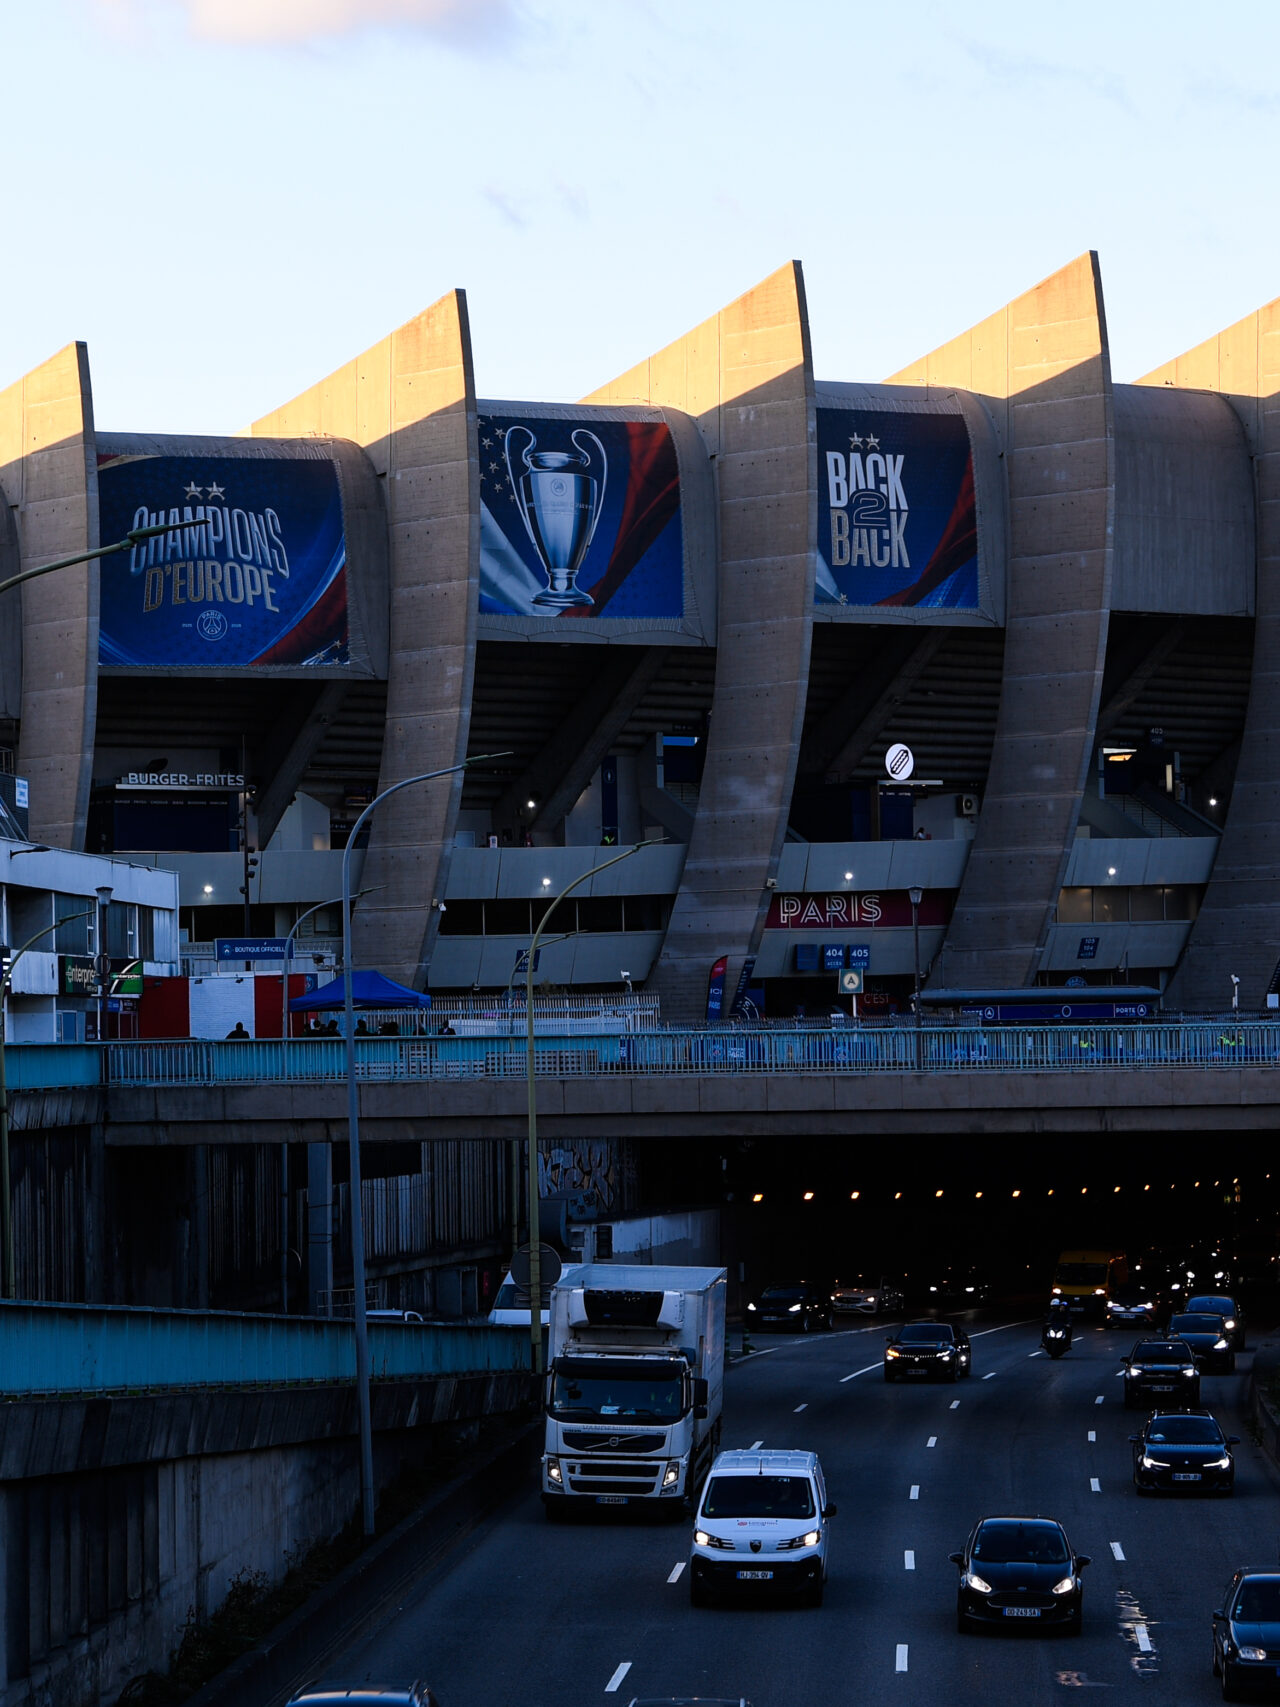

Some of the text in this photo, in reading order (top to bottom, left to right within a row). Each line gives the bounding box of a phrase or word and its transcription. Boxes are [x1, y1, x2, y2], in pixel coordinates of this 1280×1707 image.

[826, 451, 909, 510] BACK
[852, 491, 888, 527] 2
[130, 505, 290, 579] CHAMPIONS
[830, 508, 911, 568] BACK
[143, 560, 280, 613] D'EUROPE
[128, 772, 245, 786] BURGER-FRITES
[779, 894, 882, 923] PARIS
[826, 949, 843, 957] 404
[851, 949, 869, 957] 405
[65, 964, 98, 989] enterpris
[847, 975, 856, 985] A
[864, 993, 888, 1004] C'EST
